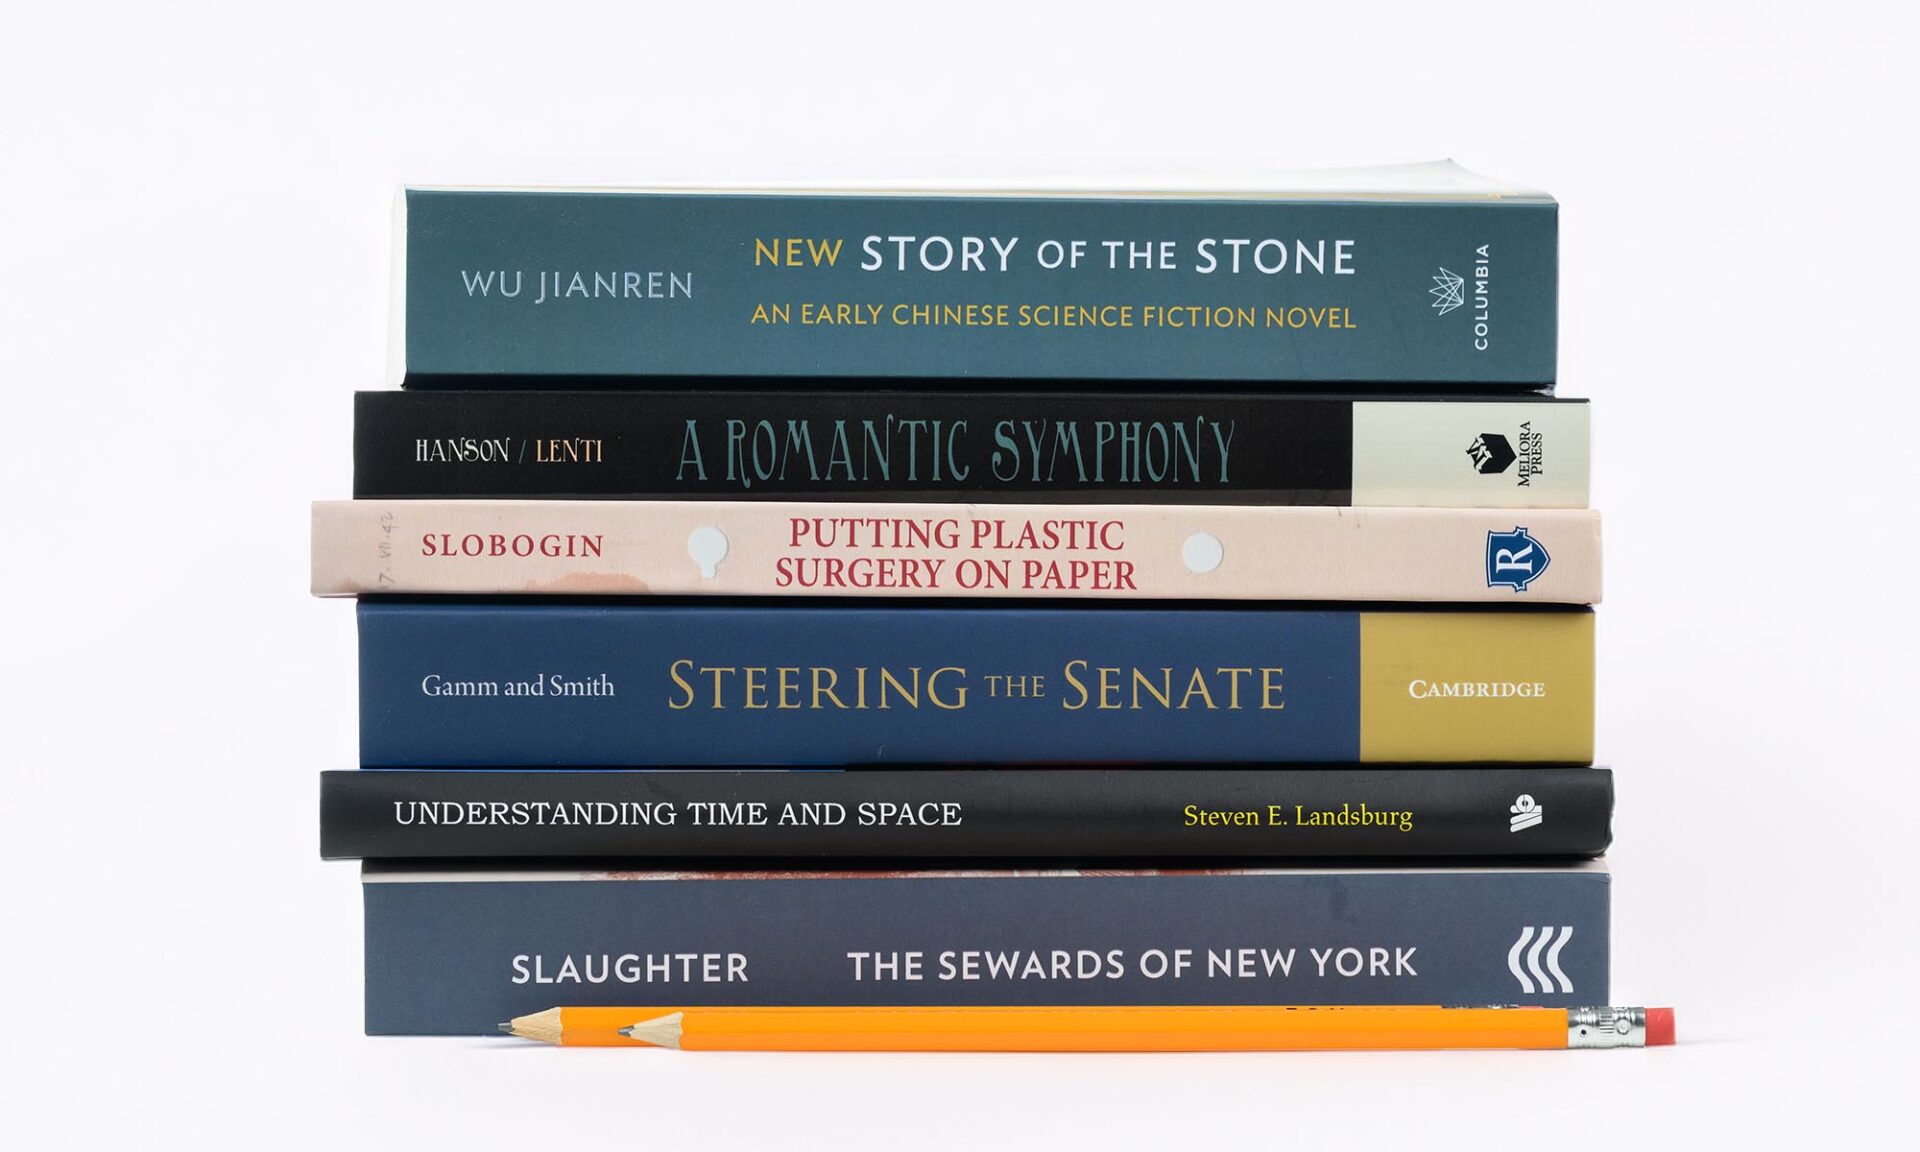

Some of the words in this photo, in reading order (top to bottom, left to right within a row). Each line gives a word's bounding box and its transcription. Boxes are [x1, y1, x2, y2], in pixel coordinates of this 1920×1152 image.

[756, 238, 843, 266] NEW
[861, 236, 1018, 271] STORY
[1038, 240, 1086, 268] OF
[1102, 241, 1176, 269] THE
[1196, 238, 1355, 274] STONE
[462, 271, 521, 297] WU
[535, 271, 693, 304] JIANREN
[1475, 245, 1488, 350] COLUMBIA
[751, 304, 789, 324] AN
[802, 304, 883, 324] EARLY
[892, 304, 1008, 325] CHINESE
[1019, 305, 1133, 327] SCIENCE
[1144, 306, 1255, 327] FICTION
[1267, 307, 1356, 328] NOVEL
[417, 437, 510, 461] HANSON
[537, 438, 601, 462] LENTI
[676, 420, 707, 480] A
[726, 414, 969, 488] ROMANTIC
[992, 416, 1234, 482] SYMPHONY
[1518, 421, 1531, 487] MELIORA
[1531, 432, 1543, 475] PRESS
[422, 534, 603, 557] SLOBOGIN
[789, 518, 960, 549] PUTTING
[971, 520, 1124, 550] PLASTIC
[775, 558, 945, 589] SURGERY
[956, 559, 1011, 589] ON
[1021, 560, 1138, 591] PAPER
[422, 675, 498, 696] Gamm
[505, 674, 544, 696] and
[550, 674, 614, 696] Smith
[669, 660, 968, 709] STEERING
[984, 676, 1044, 697] THE
[1063, 660, 1284, 709] SENATE
[1409, 680, 1545, 698] CAMBRIDGE
[394, 802, 677, 825] UNDERSTANDING
[687, 802, 767, 825] TIME
[778, 803, 845, 825] AND
[859, 803, 962, 825] SPACE
[1185, 805, 1259, 825] Steven
[1268, 805, 1287, 825] E.
[1295, 803, 1413, 831] Landsburg
[512, 953, 748, 984] SLAUGHTER
[847, 952, 923, 980] THE
[939, 950, 1124, 980] SEWARDS
[1140, 949, 1192, 978] OF
[1209, 949, 1295, 977] NEW
[1310, 947, 1417, 976] YORK
